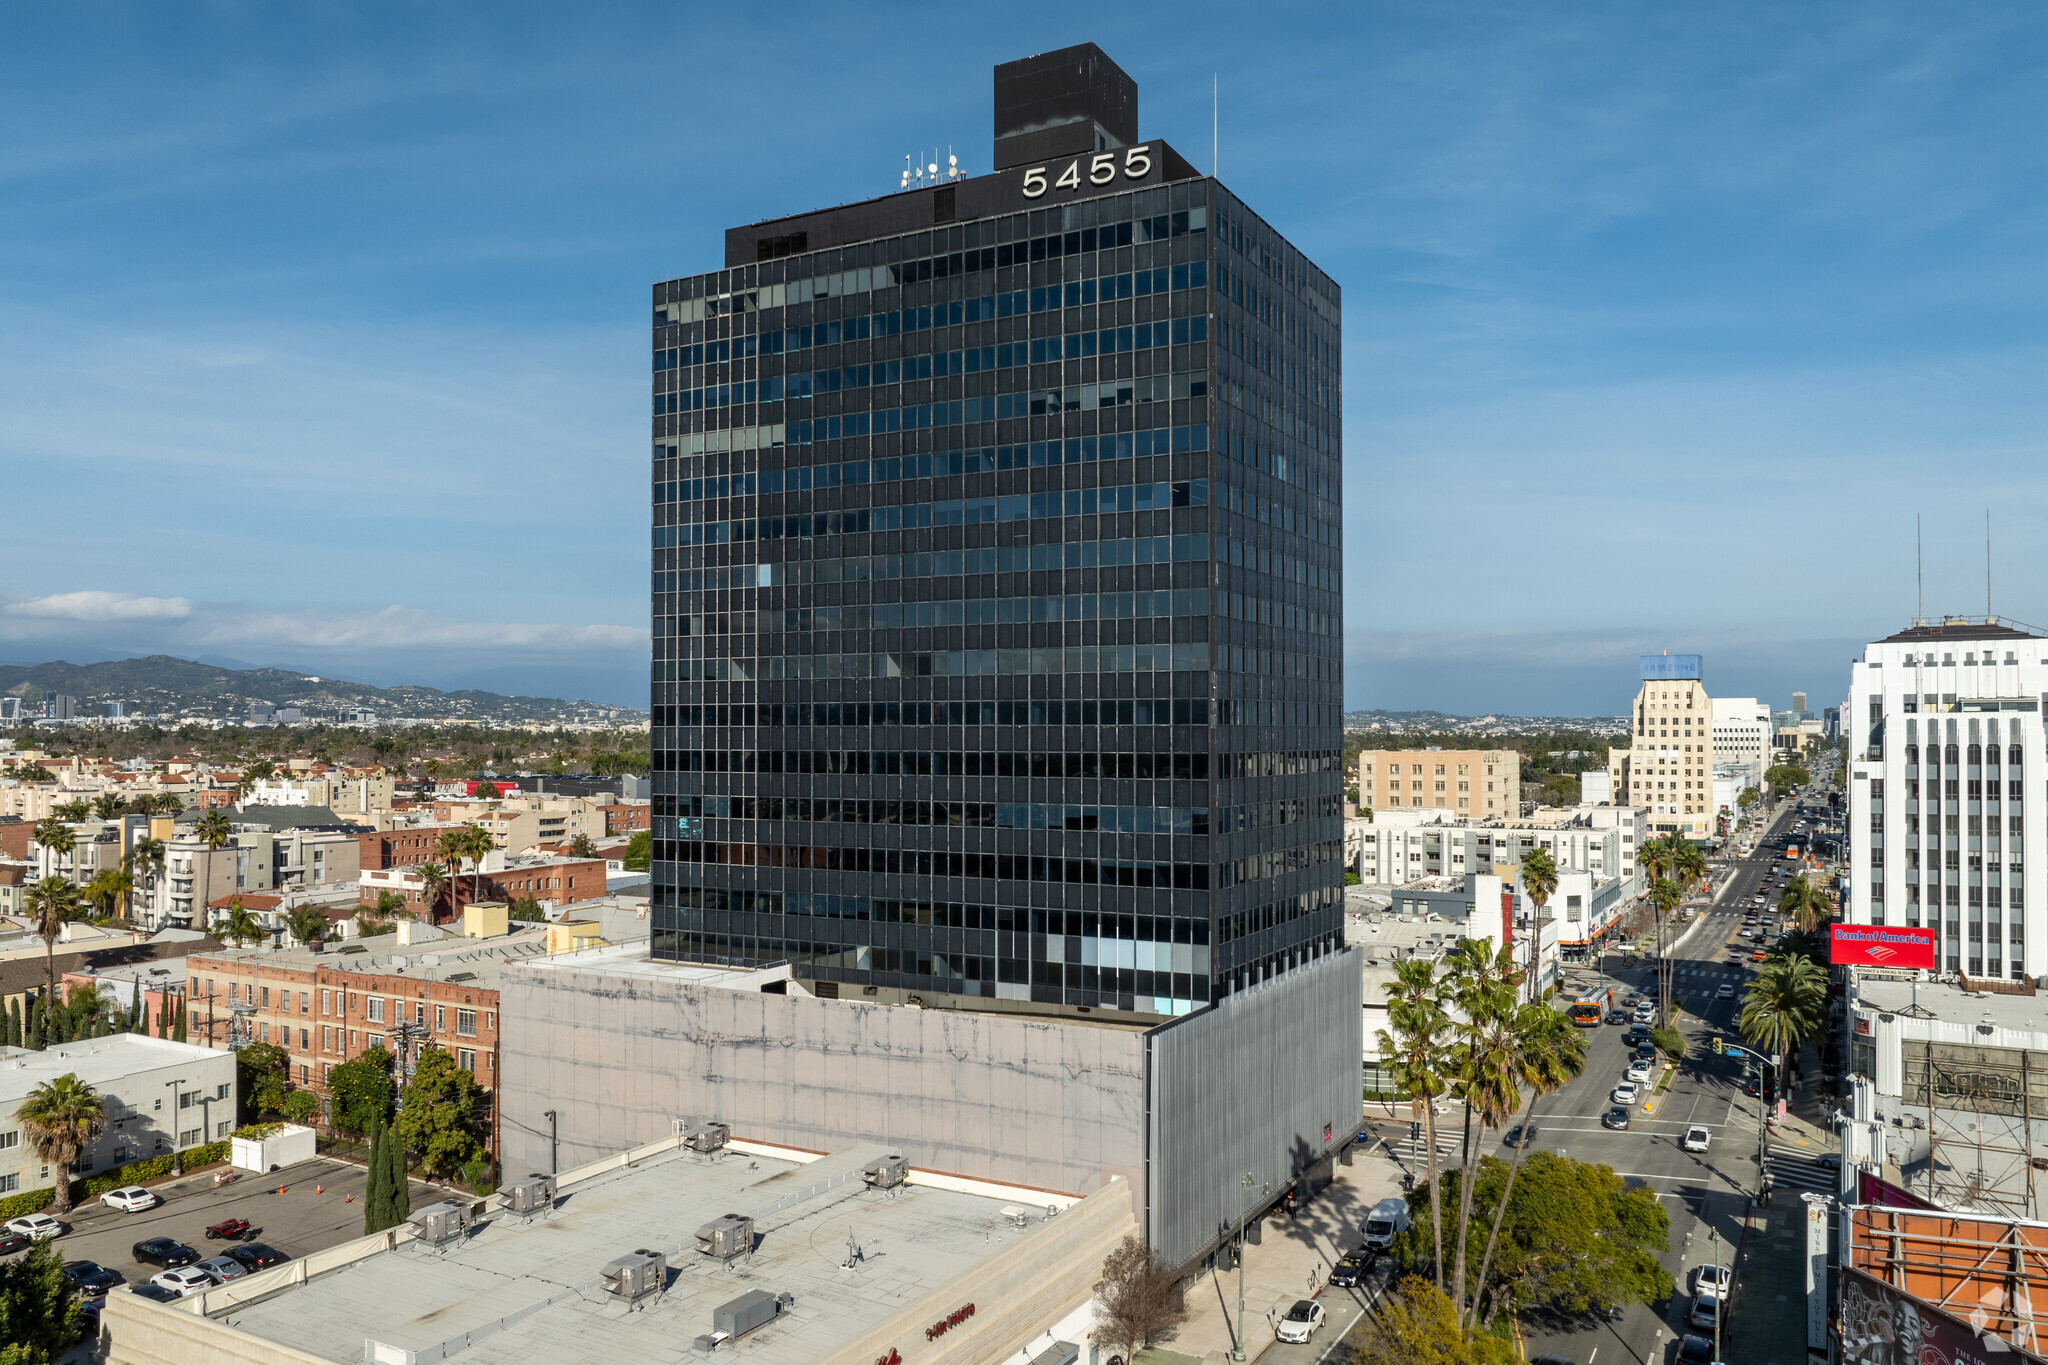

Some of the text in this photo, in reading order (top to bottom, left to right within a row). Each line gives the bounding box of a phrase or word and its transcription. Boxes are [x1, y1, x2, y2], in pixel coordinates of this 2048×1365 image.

[1022, 145, 1152, 200] 5455
[1643, 663, 1696, 672] SAMSUNG
[1835, 929, 1930, 945] Bank of America
[925, 1302, 976, 1342] 1-HR PHOTO
[1954, 1347, 1971, 1362] THE
